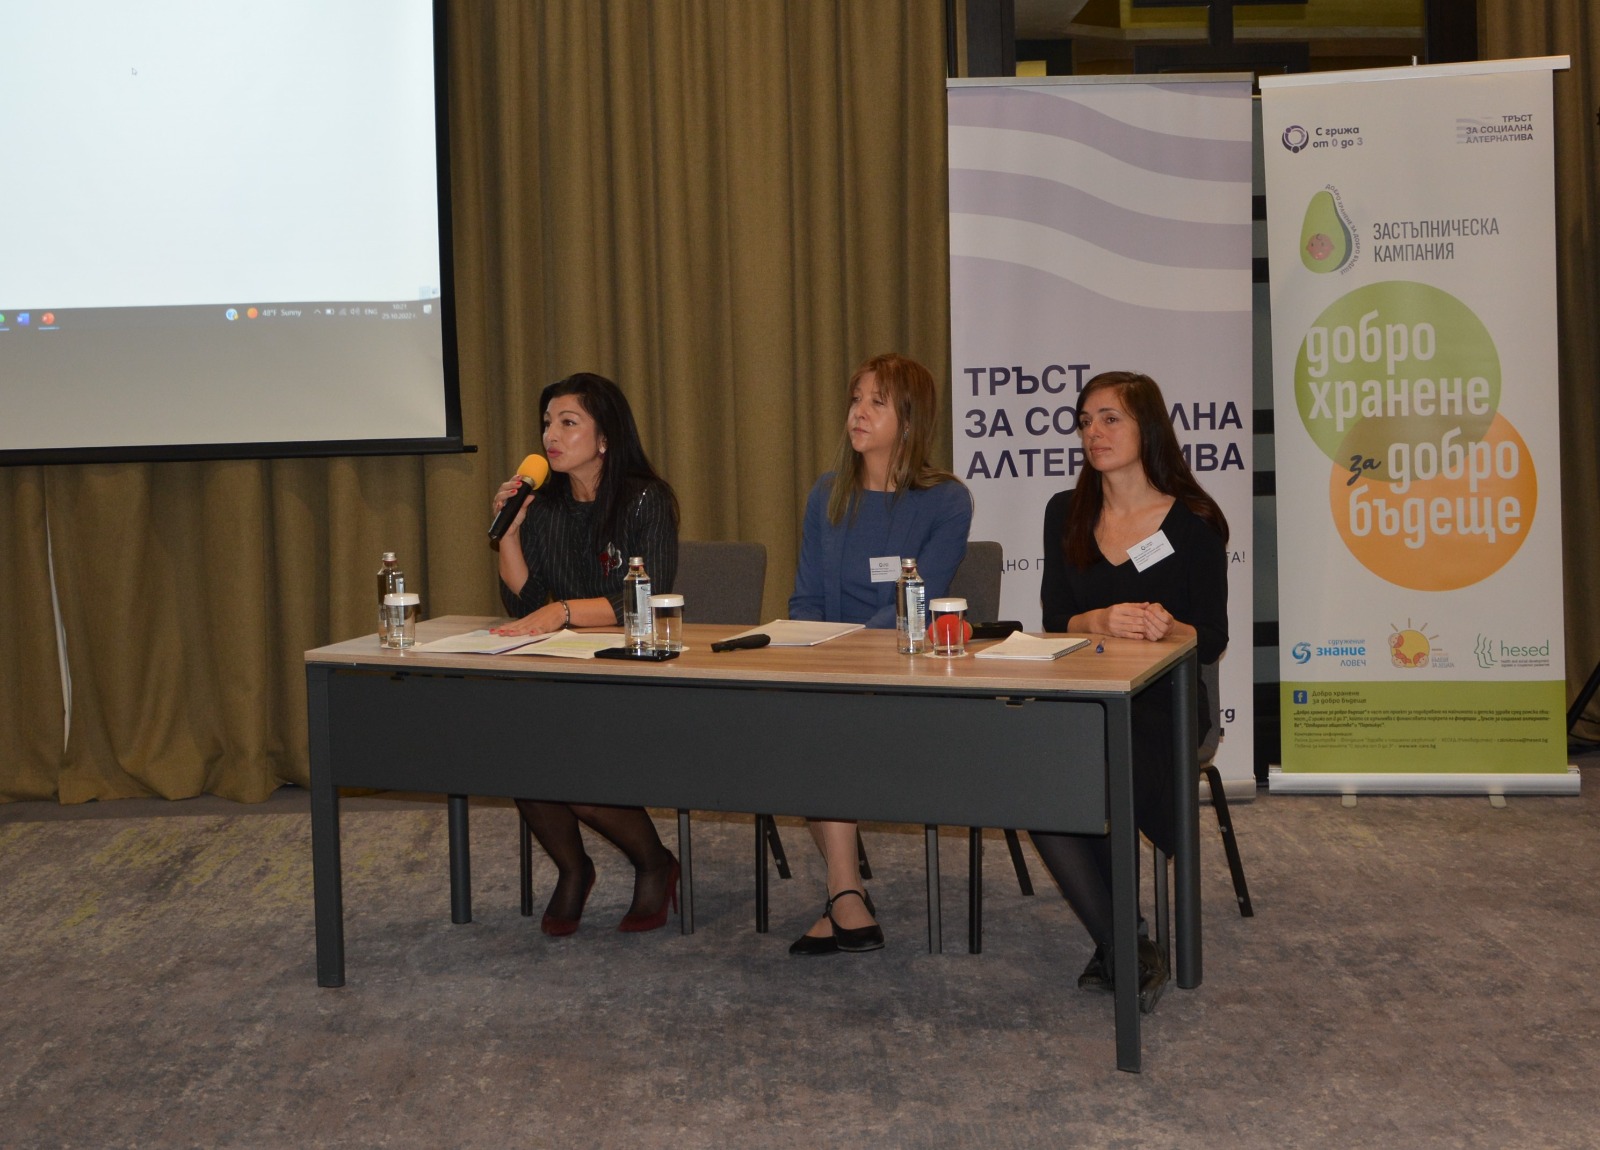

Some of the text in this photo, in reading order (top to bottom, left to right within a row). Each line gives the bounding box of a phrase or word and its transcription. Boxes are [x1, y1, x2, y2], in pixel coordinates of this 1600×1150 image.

[1502, 114, 1533, 122] ТРЪСТ
[1315, 127, 1360, 137] С грижа
[1480, 124, 1533, 134] СОЦИАЛНА
[1331, 138, 1338, 147] 0
[1341, 139, 1354, 149] до
[1357, 137, 1363, 146] 3
[1466, 133, 1533, 144] АЛТЕРНАТИВА
[1373, 218, 1499, 240] ЗАСТЪПНИЧЕСКА
[1374, 242, 1455, 262] КАМПАНИЯ
[281, 308, 302, 318] Sunny
[1306, 309, 1436, 378] добро
[964, 364, 1090, 396] ТРЪСТ
[1308, 374, 1490, 432] хранене
[964, 408, 1014, 438] ЗА
[1346, 427, 1520, 494] за добро
[1349, 484, 1521, 549] бъдеще
[1316, 646, 1366, 656] знание
[1500, 640, 1549, 656] hesed
[1340, 659, 1367, 667] ЛОВЕЧ
